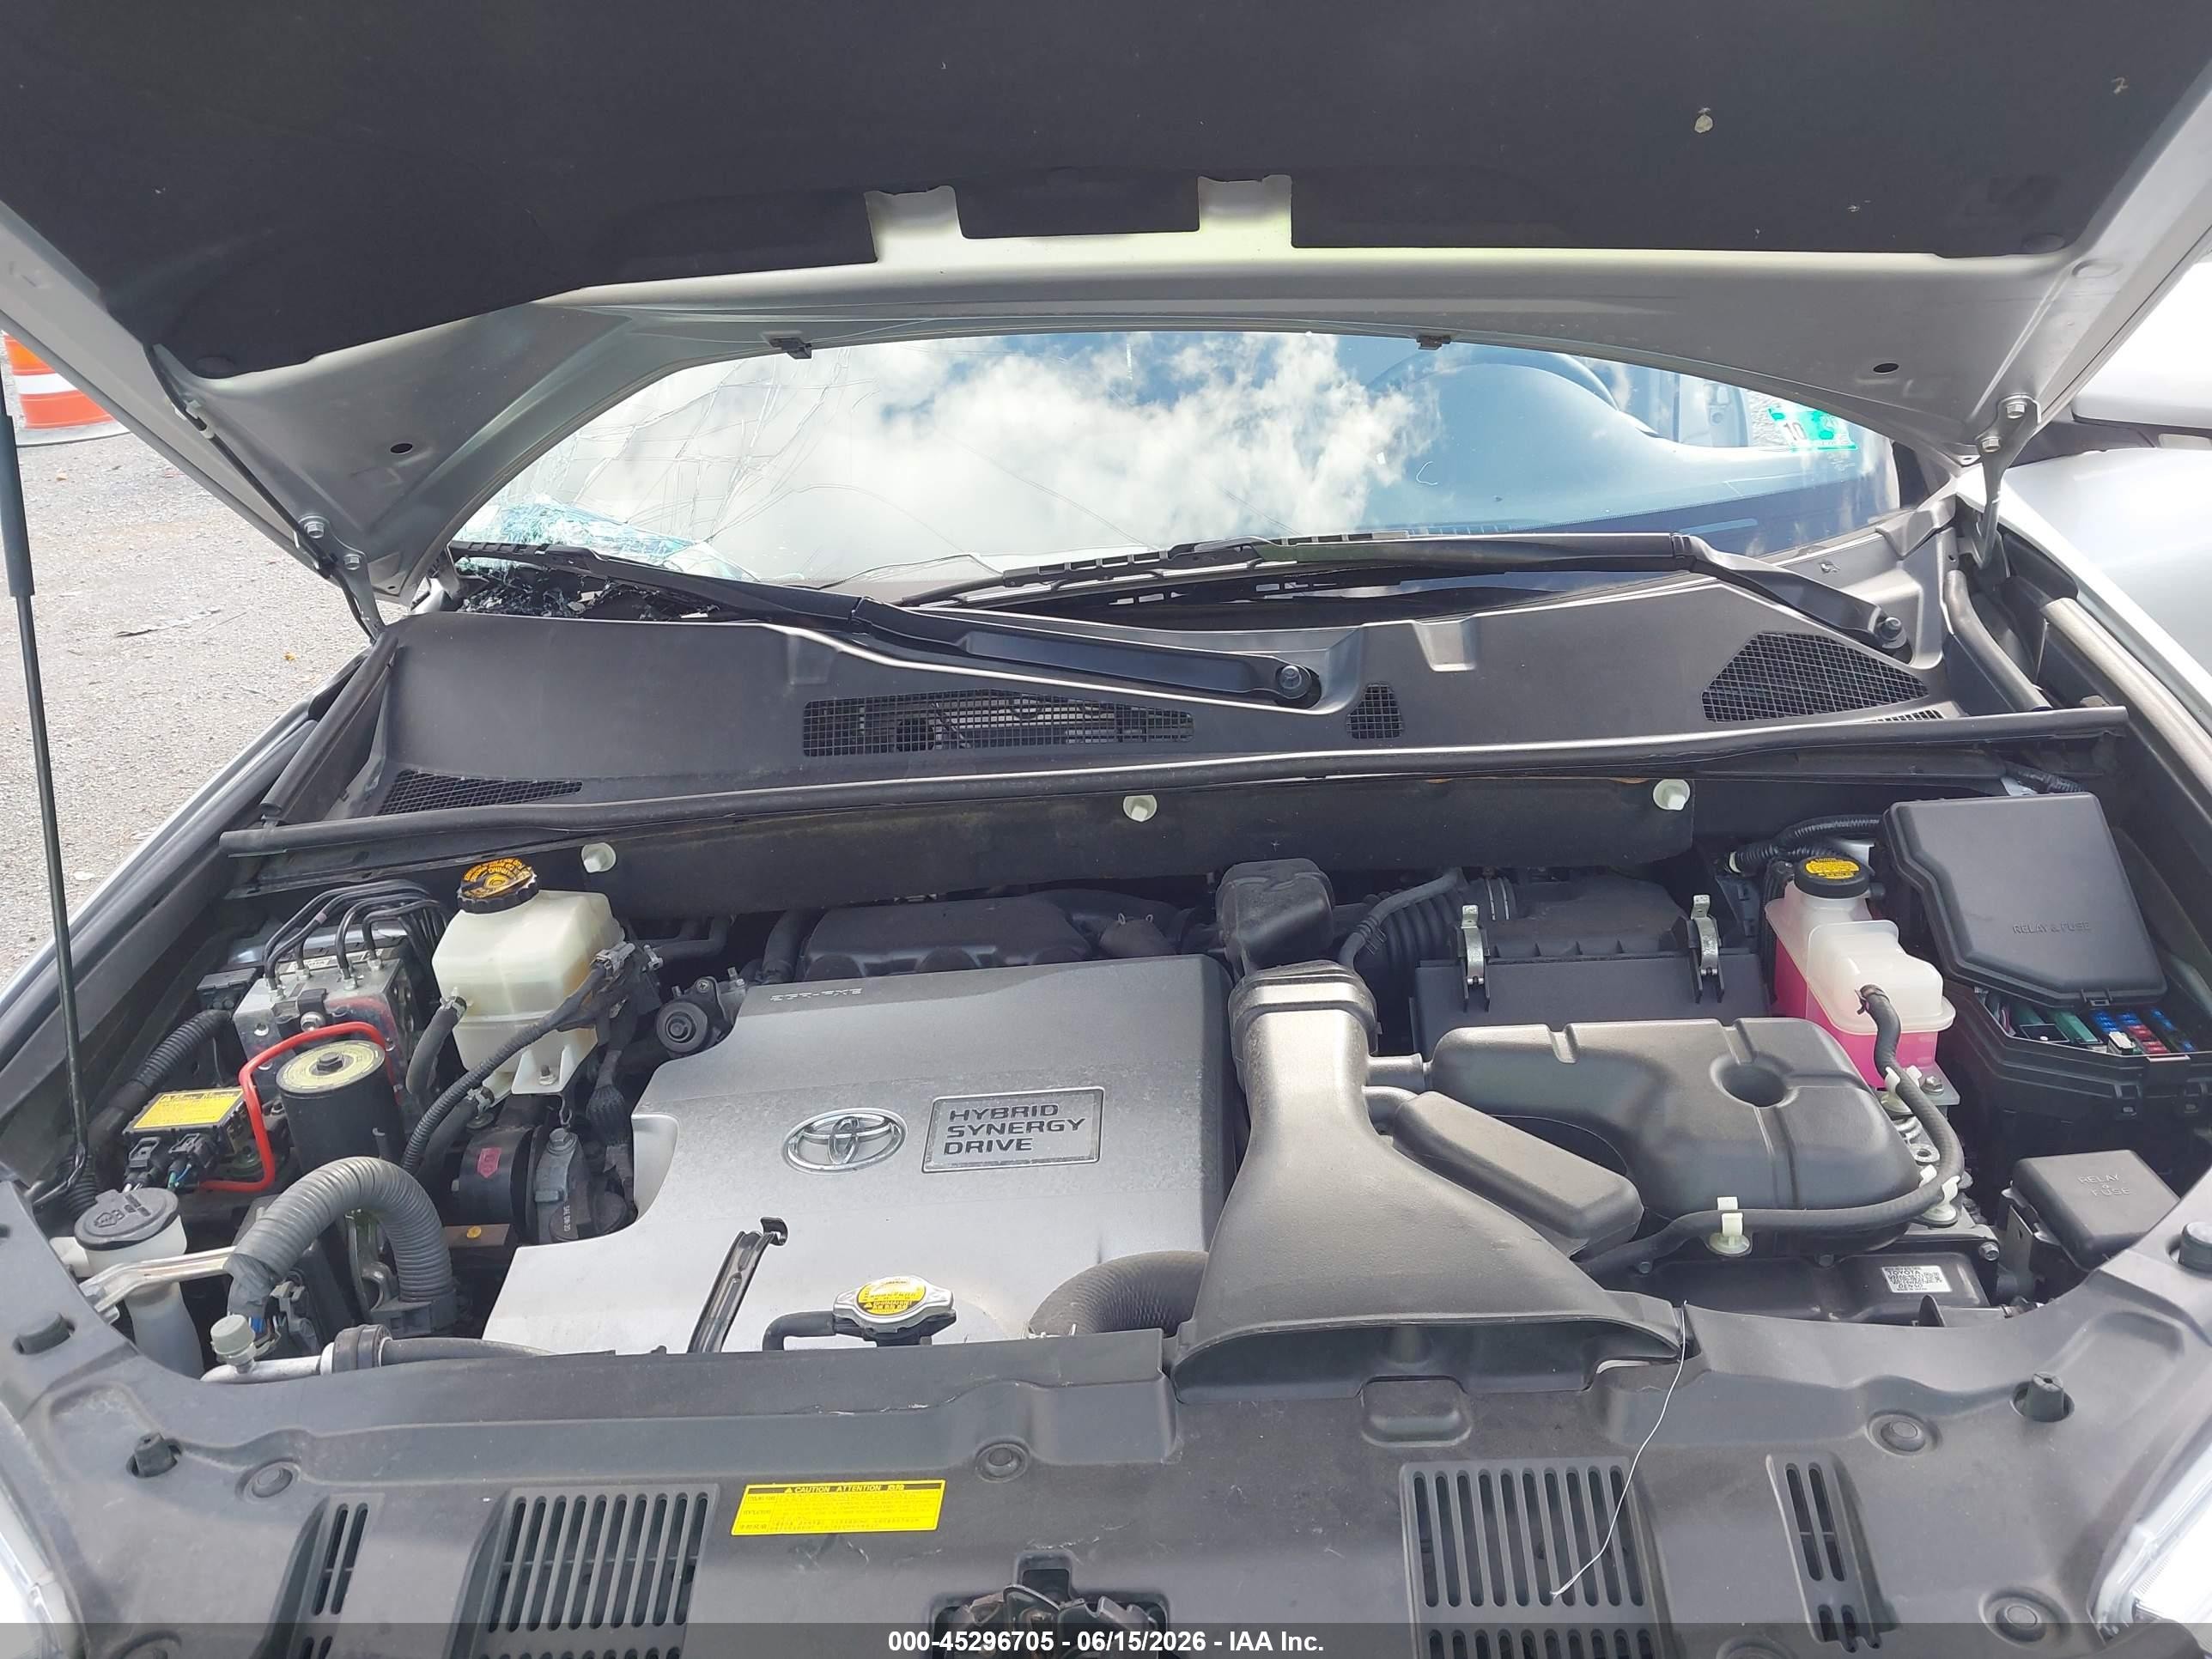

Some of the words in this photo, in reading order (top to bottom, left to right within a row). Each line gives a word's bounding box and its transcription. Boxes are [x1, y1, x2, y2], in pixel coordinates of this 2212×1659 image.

[2012, 922, 2048, 934] RELAY
[2061, 921, 2092, 933] FUSE
[949, 1103, 1059, 1121] HYBRID
[947, 1118, 1085, 1139] SYNERGY
[944, 1138, 1033, 1155] DRIVE
[2078, 1174, 2119, 1184] RELAY
[2090, 1188, 2130, 1197] FUSE
[836, 1484, 883, 1492] ATTENTION
